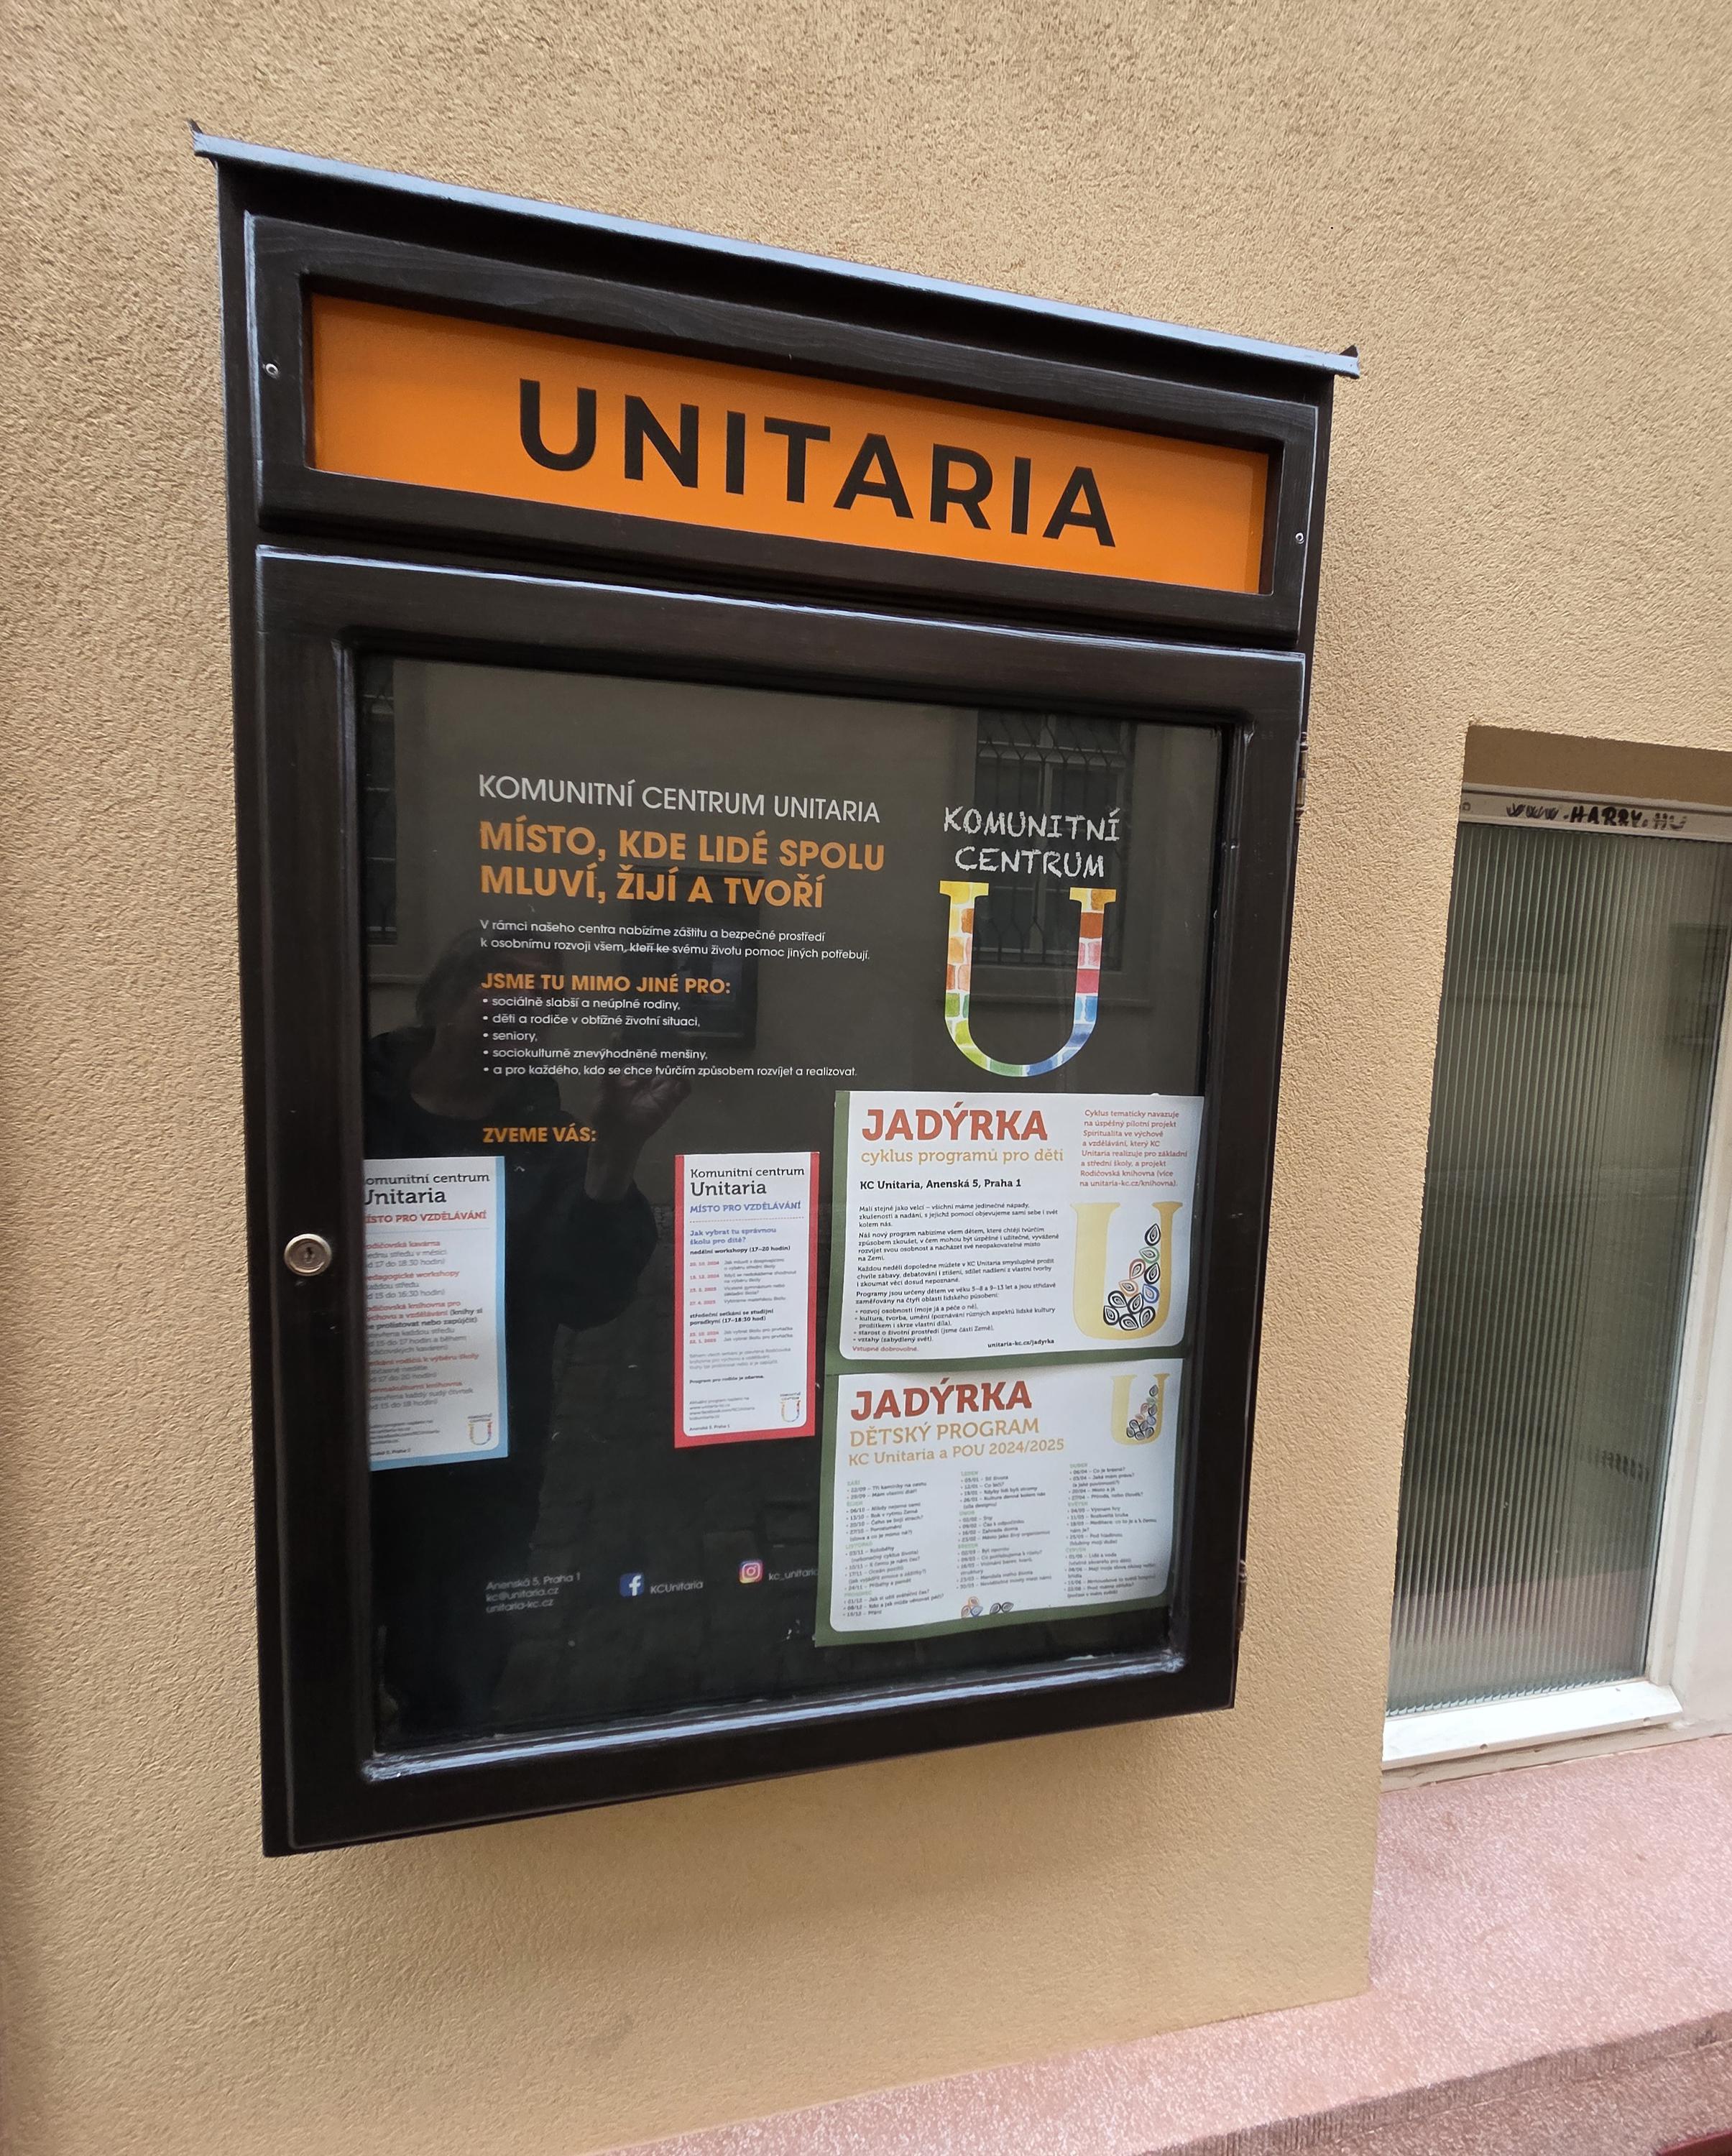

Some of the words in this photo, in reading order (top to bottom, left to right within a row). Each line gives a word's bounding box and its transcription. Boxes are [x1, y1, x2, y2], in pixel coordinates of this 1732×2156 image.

[520, 379, 1115, 547] UNITARIA
[479, 774, 635, 806] KOMUNITNÍ
[642, 786, 764, 816] CENTRUM
[774, 795, 880, 823] UNITARIA
[944, 806, 1120, 842] KOMUNITNÍ
[479, 816, 606, 862] MÍSTO,
[619, 829, 686, 860] KDE
[699, 831, 768, 865] LIDÉ
[778, 839, 884, 870] SPOLU
[955, 846, 1104, 878] CENTRUM
[481, 865, 605, 903] MLUVÍ,
[616, 865, 678, 901] ŽIJÍ
[687, 876, 713, 903] A
[724, 873, 826, 908] TVOŘÍ
[479, 918, 489, 929] V
[492, 918, 528, 931] rámci
[530, 921, 576, 933] našeho
[577, 923, 616, 934] centra
[618, 924, 672, 936] nabízíme
[673, 926, 707, 938] záštitu
[709, 929, 719, 938] a
[720, 928, 776, 941] bezpečné
[778, 931, 826, 942] prostředí
[479, 936, 488, 947] k
[490, 938, 551, 949] osobnímu
[553, 940, 591, 953] rozvoji
[630, 942, 654, 953] kteří
[656, 943, 670, 954] ke
[672, 944, 709, 955] svému
[710, 944, 742, 956] životu
[744, 947, 785, 958] pomoc
[786, 946, 819, 959] jiných
[481, 972, 534, 989] JSME
[540, 974, 564, 990] TU
[571, 975, 630, 991] MIMO
[636, 973, 678, 992] JINÉ
[685, 977, 730, 993] PRO:
[491, 995, 543, 1007] sociálně
[545, 996, 580, 1008] slabší
[580, 999, 590, 1008] a
[592, 997, 641, 1010] neúplné
[492, 1013, 515, 1023] děti
[517, 1015, 528, 1024] a
[530, 1013, 569, 1025] rodiče
[580, 1014, 623, 1025] obtížné
[624, 1015, 661, 1026] životní
[492, 1047, 571, 1058] sociokulturně
[572, 1047, 658, 1060] znevýhodněné
[492, 1066, 502, 1075] a
[504, 1066, 526, 1077] pro
[583, 1064, 606, 1075] kdo
[607, 1067, 621, 1075] se
[622, 1064, 653, 1075] chce
[654, 1064, 696, 1075] tvůrčím
[697, 1064, 754, 1077] způsobem
[756, 1065, 793, 1078] rozvíjet
[795, 1067, 803, 1076] a
[862, 1101, 1047, 1141] JADÝRKA
[1084, 1108, 1109, 1118] Cyklus
[1110, 1110, 1146, 1119] tematicky
[1146, 1110, 1180, 1120] navazuje
[1094, 1119, 1125, 1128] úspěšný
[1125, 1119, 1150, 1128] pilotní
[1150, 1120, 1176, 1129] projekt
[482, 1127, 547, 1143] ZVEME
[552, 1123, 596, 1141] VÁS:
[1082, 1128, 1123, 1138] Spiritualita
[1133, 1130, 1164, 1138] výchově
[1129, 1139, 1149, 1148] který
[1149, 1139, 1161, 1148] KC
[861, 1148, 913, 1166] cyklus
[918, 1148, 998, 1165] programů
[1034, 1148, 1063, 1161] děti
[1080, 1148, 1111, 1157] Unitaria
[1111, 1149, 1143, 1158] realizuje
[1157, 1149, 1188, 1158] základní
[1140, 1159, 1166, 1169] projekt
[365, 1173, 430, 1186] omunitní
[690, 1180, 766, 1196] Unitaria
[364, 1212, 393, 1225] ÍSTO
[851, 1378, 1032, 1420] JADÝRKA
[849, 1422, 931, 1447] DĚTSKÝ
[936, 1417, 1039, 1440] PROGRAM
[848, 1452, 869, 1466] KC
[874, 1448, 934, 1464] Unitaria
[952, 1444, 985, 1457] POU
[989, 1438, 1064, 1455] 2024/2025
[486, 1577, 530, 1590] Anenská
[543, 1575, 574, 1585] Praha
[650, 1581, 704, 1595] KCUnitaria
